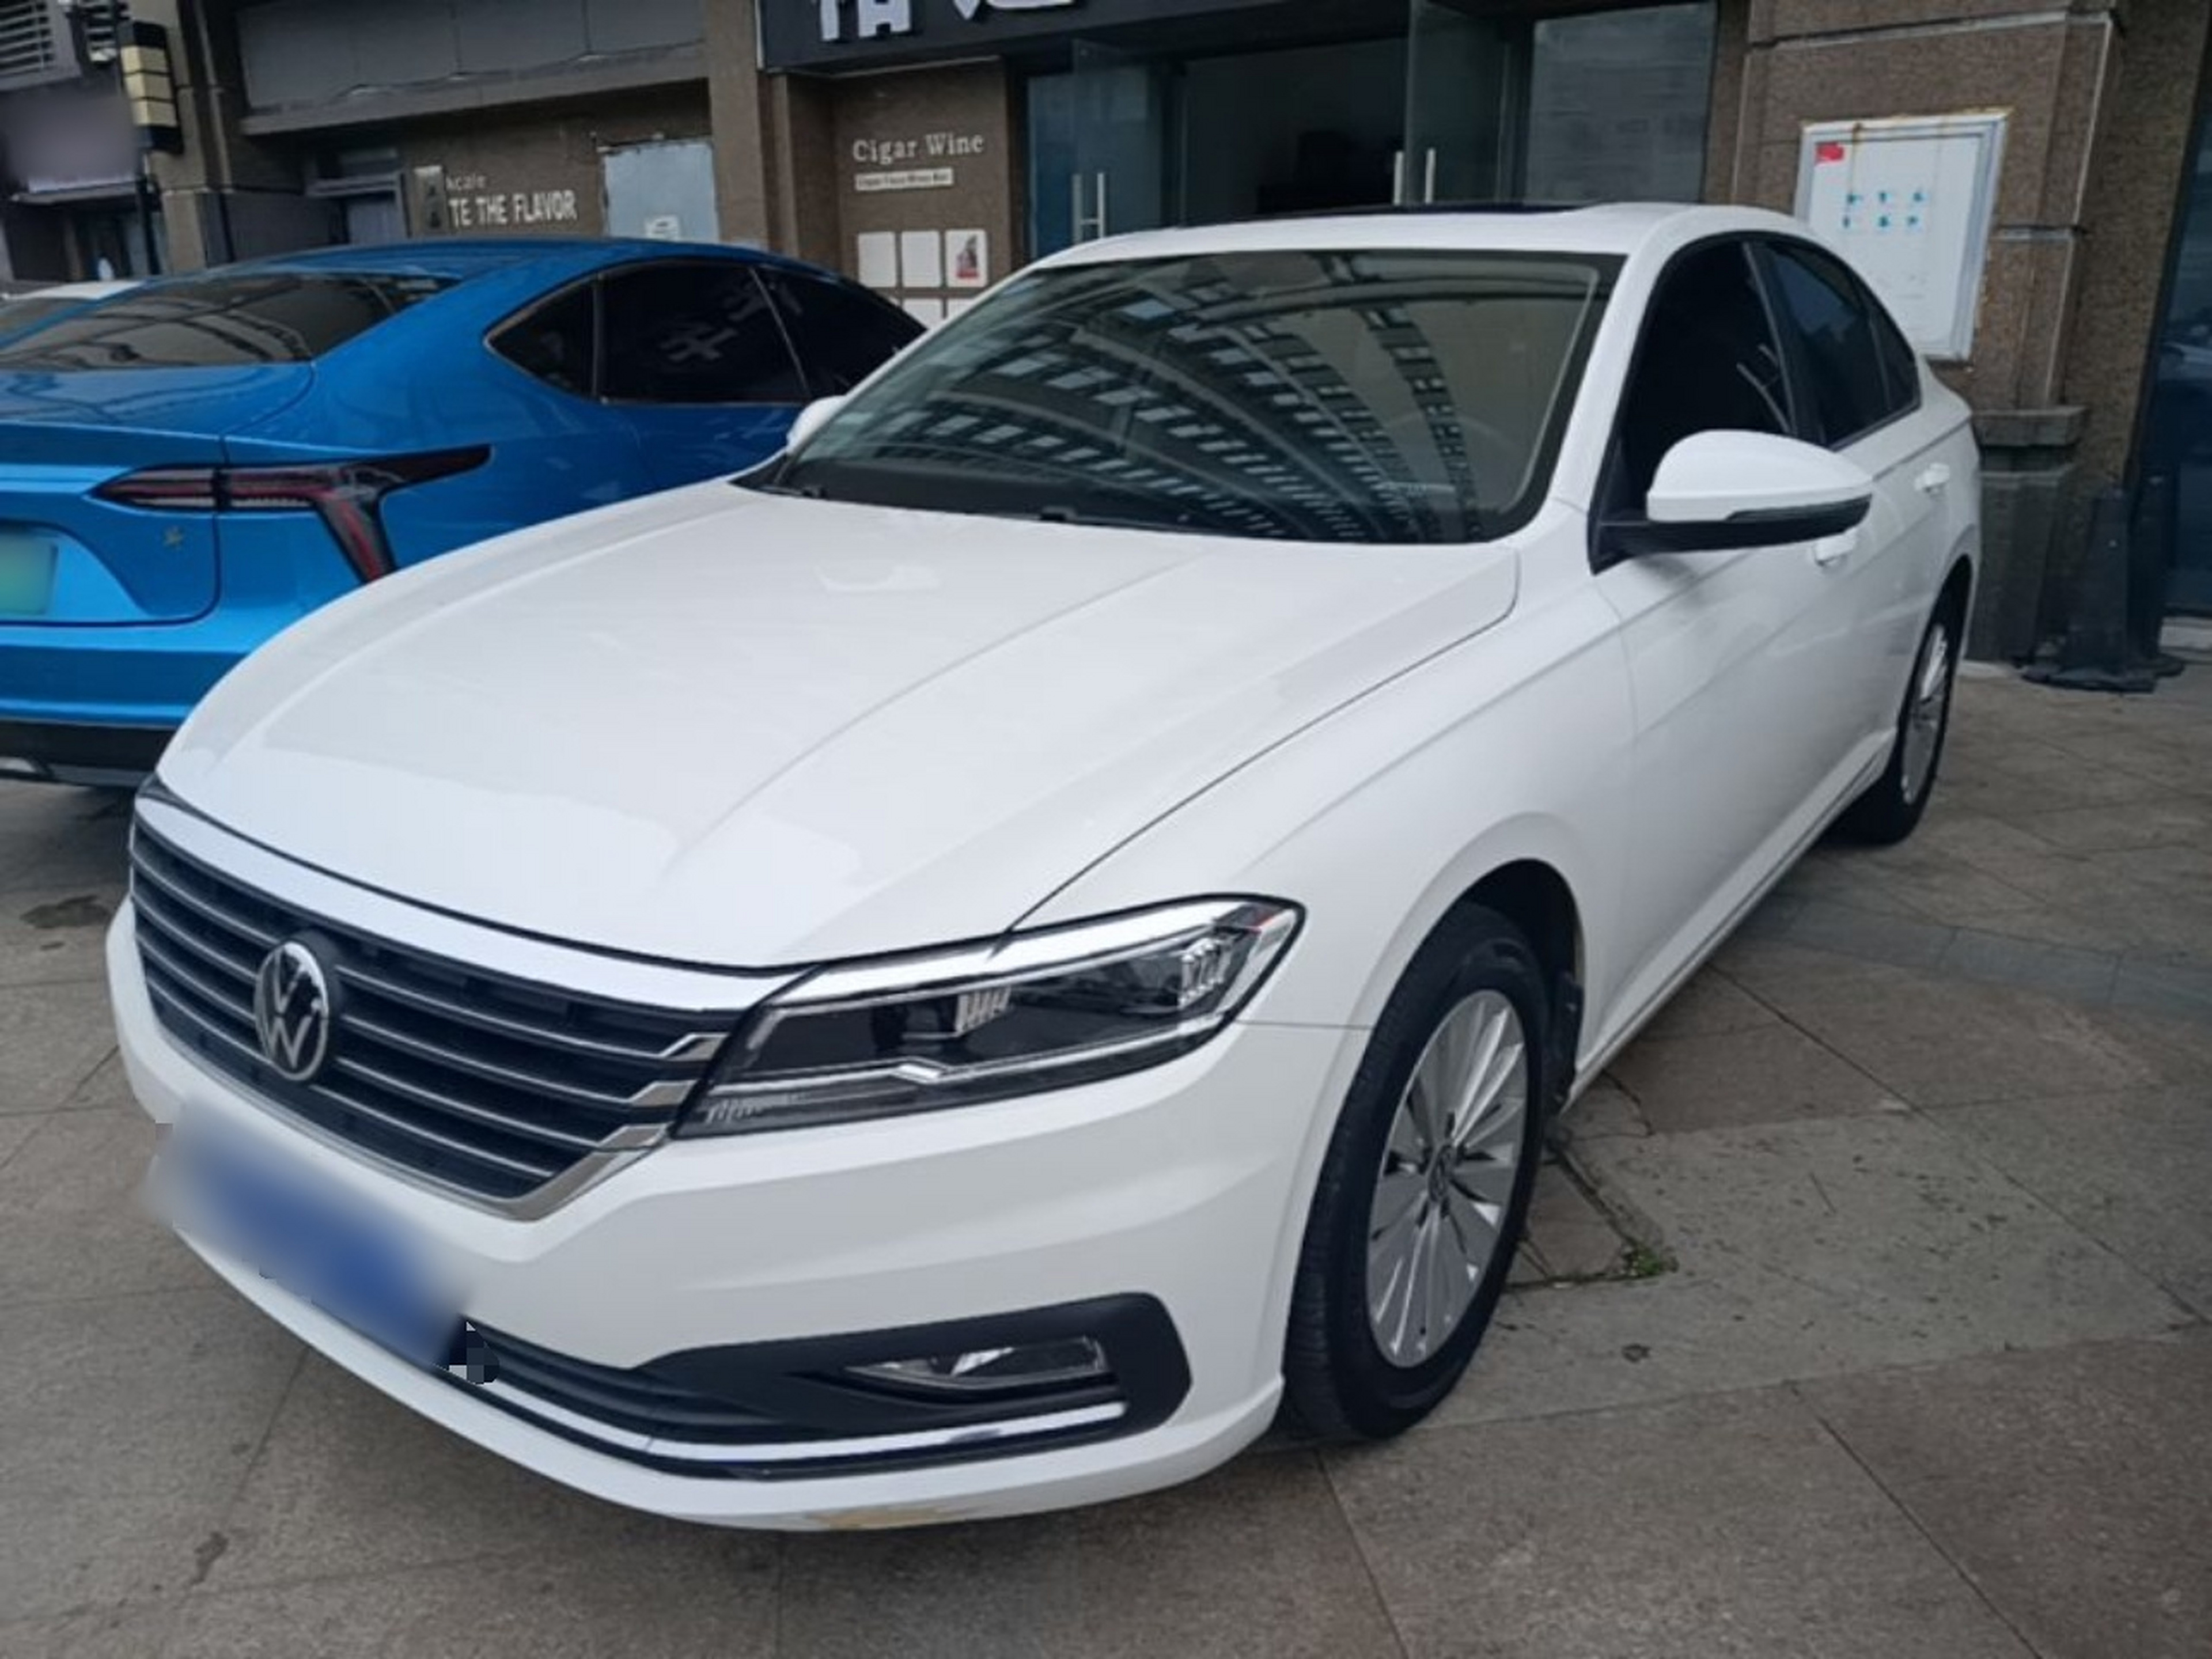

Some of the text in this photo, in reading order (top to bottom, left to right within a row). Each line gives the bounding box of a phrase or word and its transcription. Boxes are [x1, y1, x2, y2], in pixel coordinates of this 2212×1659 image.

[853, 131, 985, 165] Cigar Wine
[475, 194, 507, 226] THE
[512, 188, 578, 224] FLAVOR
